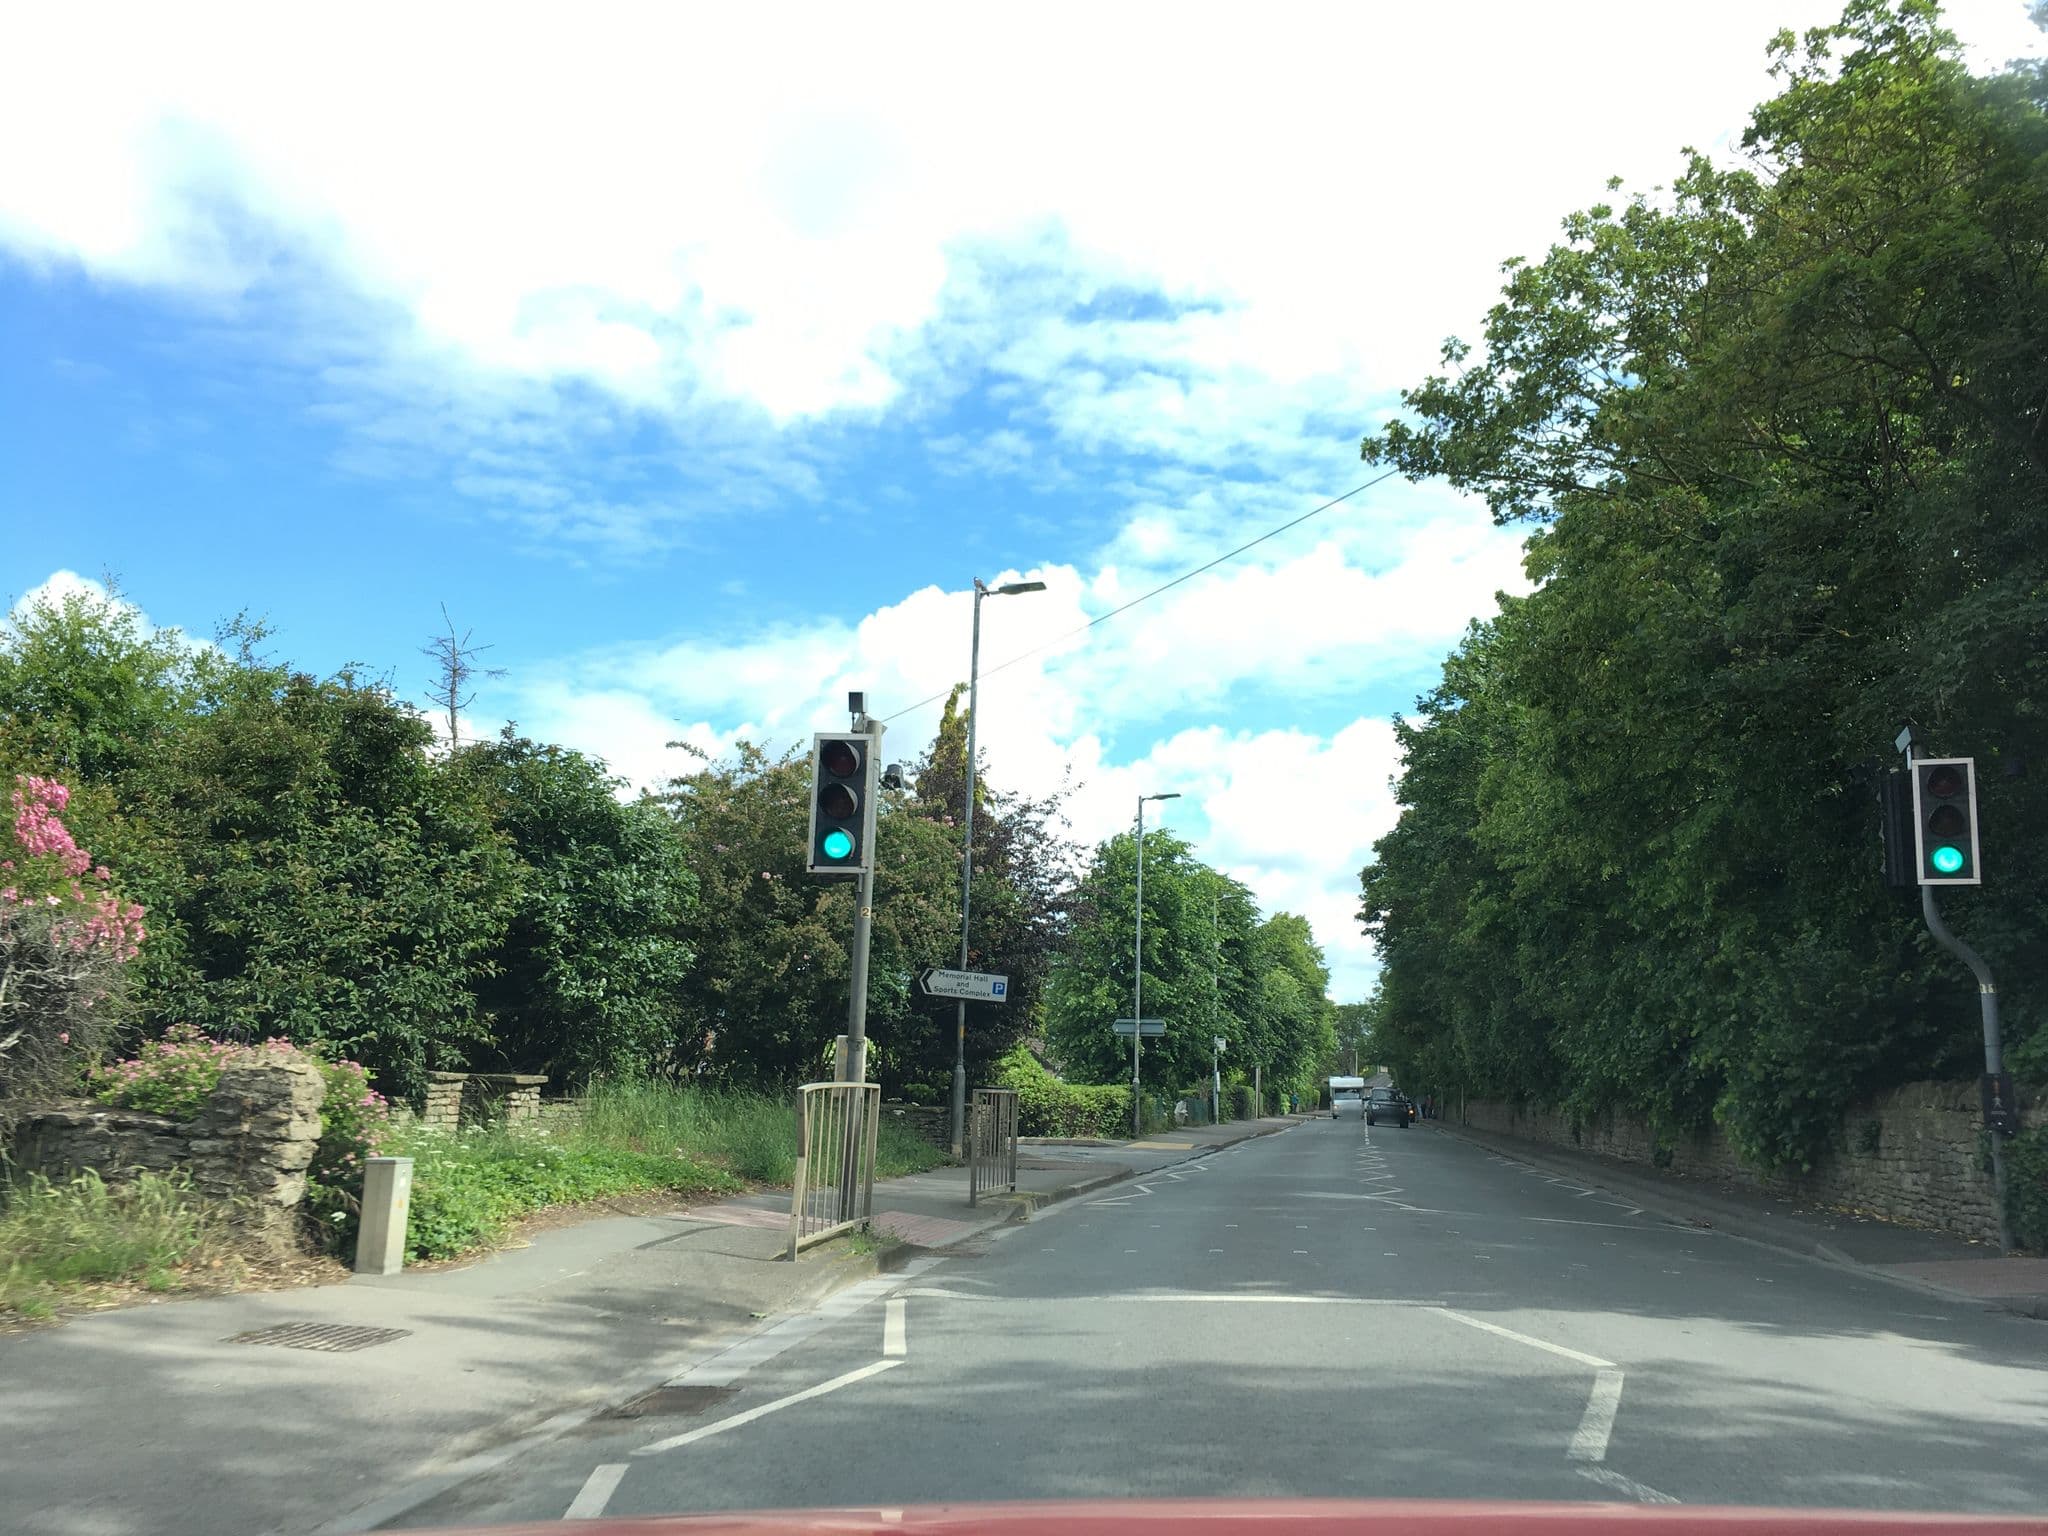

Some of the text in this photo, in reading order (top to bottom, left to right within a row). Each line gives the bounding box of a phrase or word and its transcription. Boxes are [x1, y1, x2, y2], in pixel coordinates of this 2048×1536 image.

[862, 907, 869, 916] 2
[938, 971, 971, 981] Memorial
[934, 985, 991, 998] Sports Complex
[995, 983, 1003, 993] P
